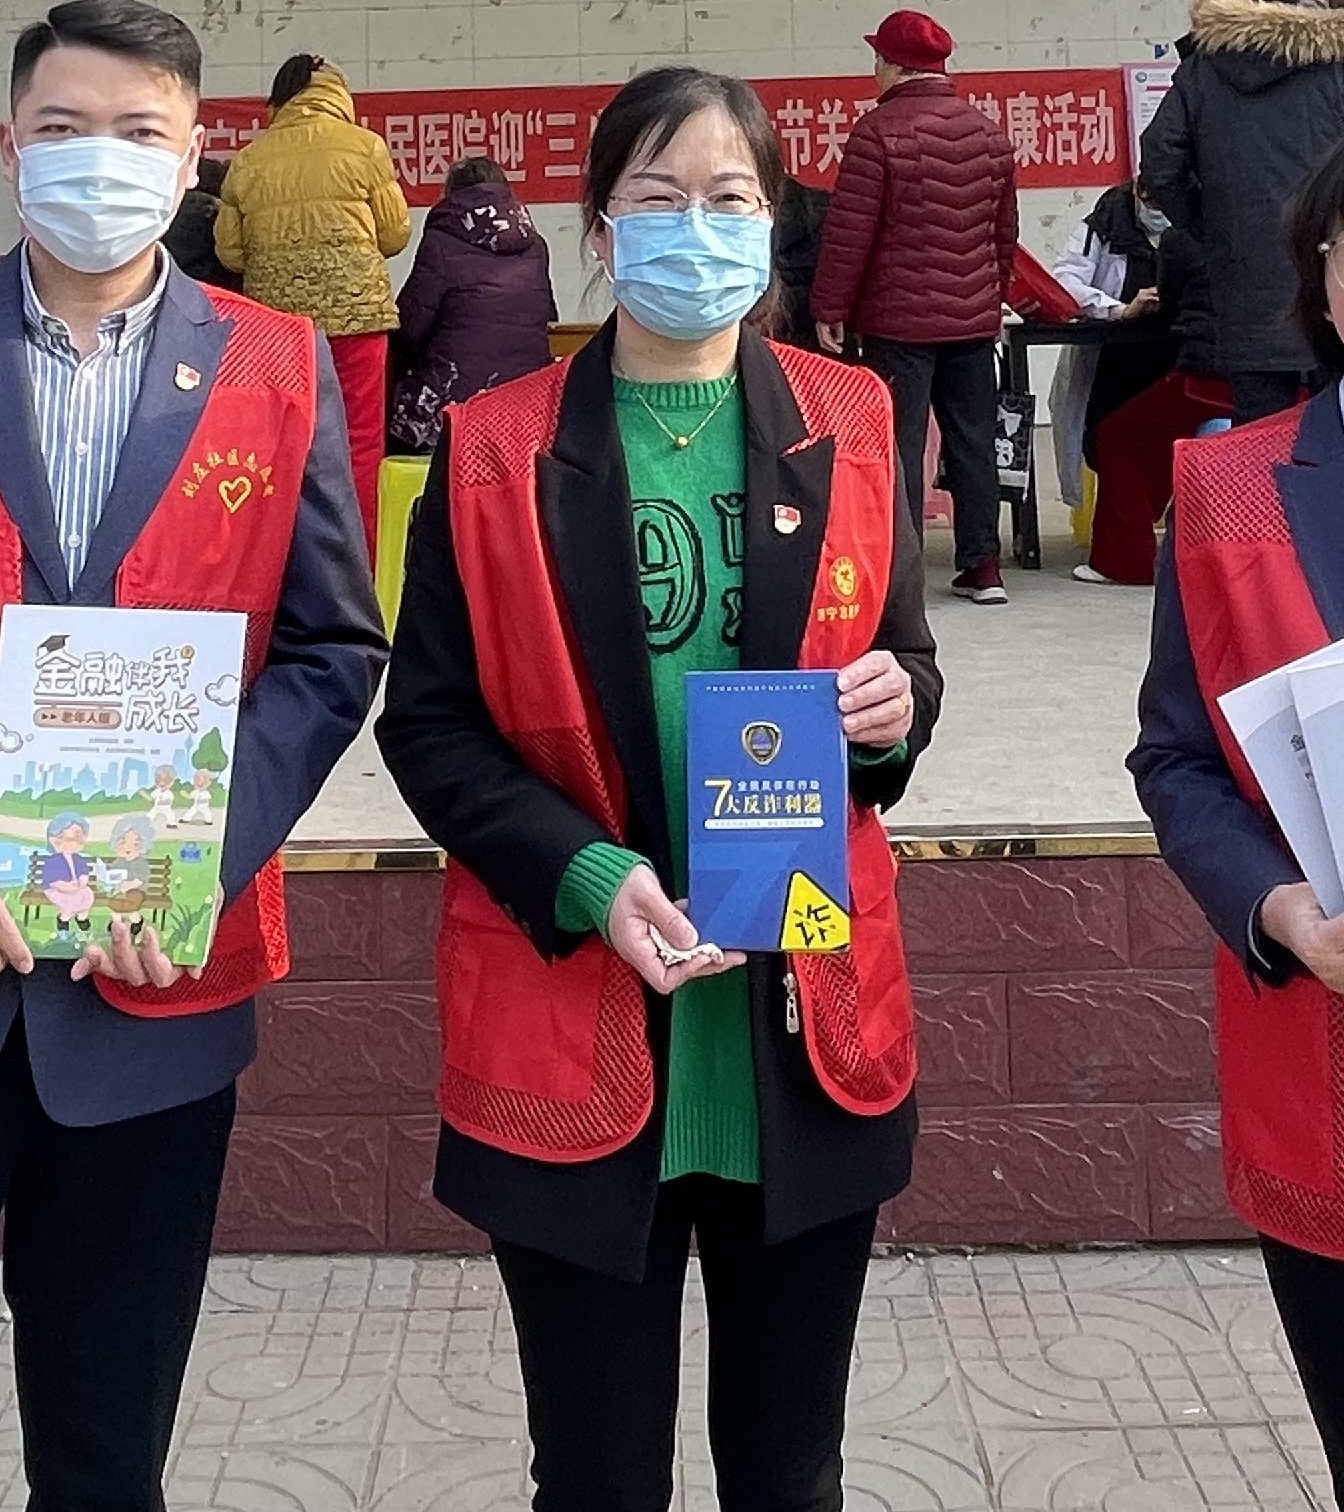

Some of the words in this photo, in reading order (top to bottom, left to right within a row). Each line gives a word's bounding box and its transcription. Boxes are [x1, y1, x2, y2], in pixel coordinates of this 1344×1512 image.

[33, 646, 192, 697] 金融伴我
[124, 690, 199, 733] 成长
